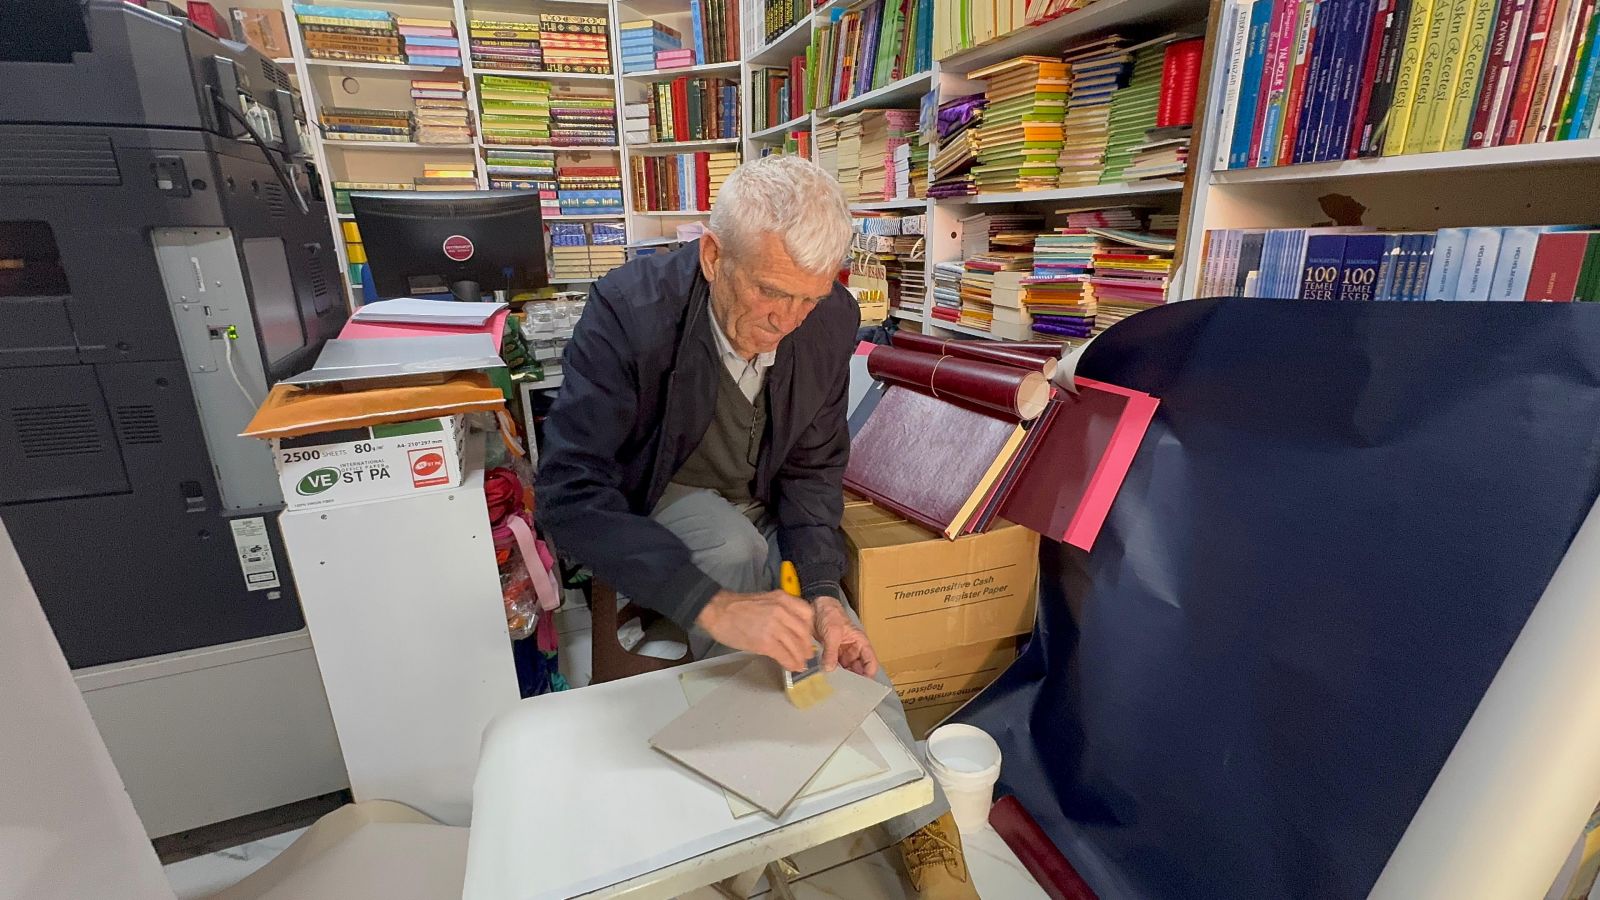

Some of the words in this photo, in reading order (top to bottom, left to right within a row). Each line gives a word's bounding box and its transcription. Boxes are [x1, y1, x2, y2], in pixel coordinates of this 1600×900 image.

[1494, 19, 1509, 56] NAMAZ
[1305, 266, 1337, 283] 100
[1342, 268, 1375, 285] 100
[1304, 282, 1334, 291] TEMEL
[1341, 285, 1372, 294] TEMEL
[1303, 290, 1331, 300] ESER
[284, 450, 321, 463] 2500
[322, 449, 348, 457] SHEETS
[354, 443, 372, 454] 80
[340, 459, 385, 468] INTERNATIONAL
[308, 474, 333, 488] VE
[343, 471, 364, 484] ST
[369, 468, 391, 481] PA
[894, 582, 970, 600] Thermosensitive
[973, 576, 994, 587] Cash
[944, 590, 981, 603] Register
[982, 584, 1008, 596] Paper
[906, 683, 944, 694] Register
